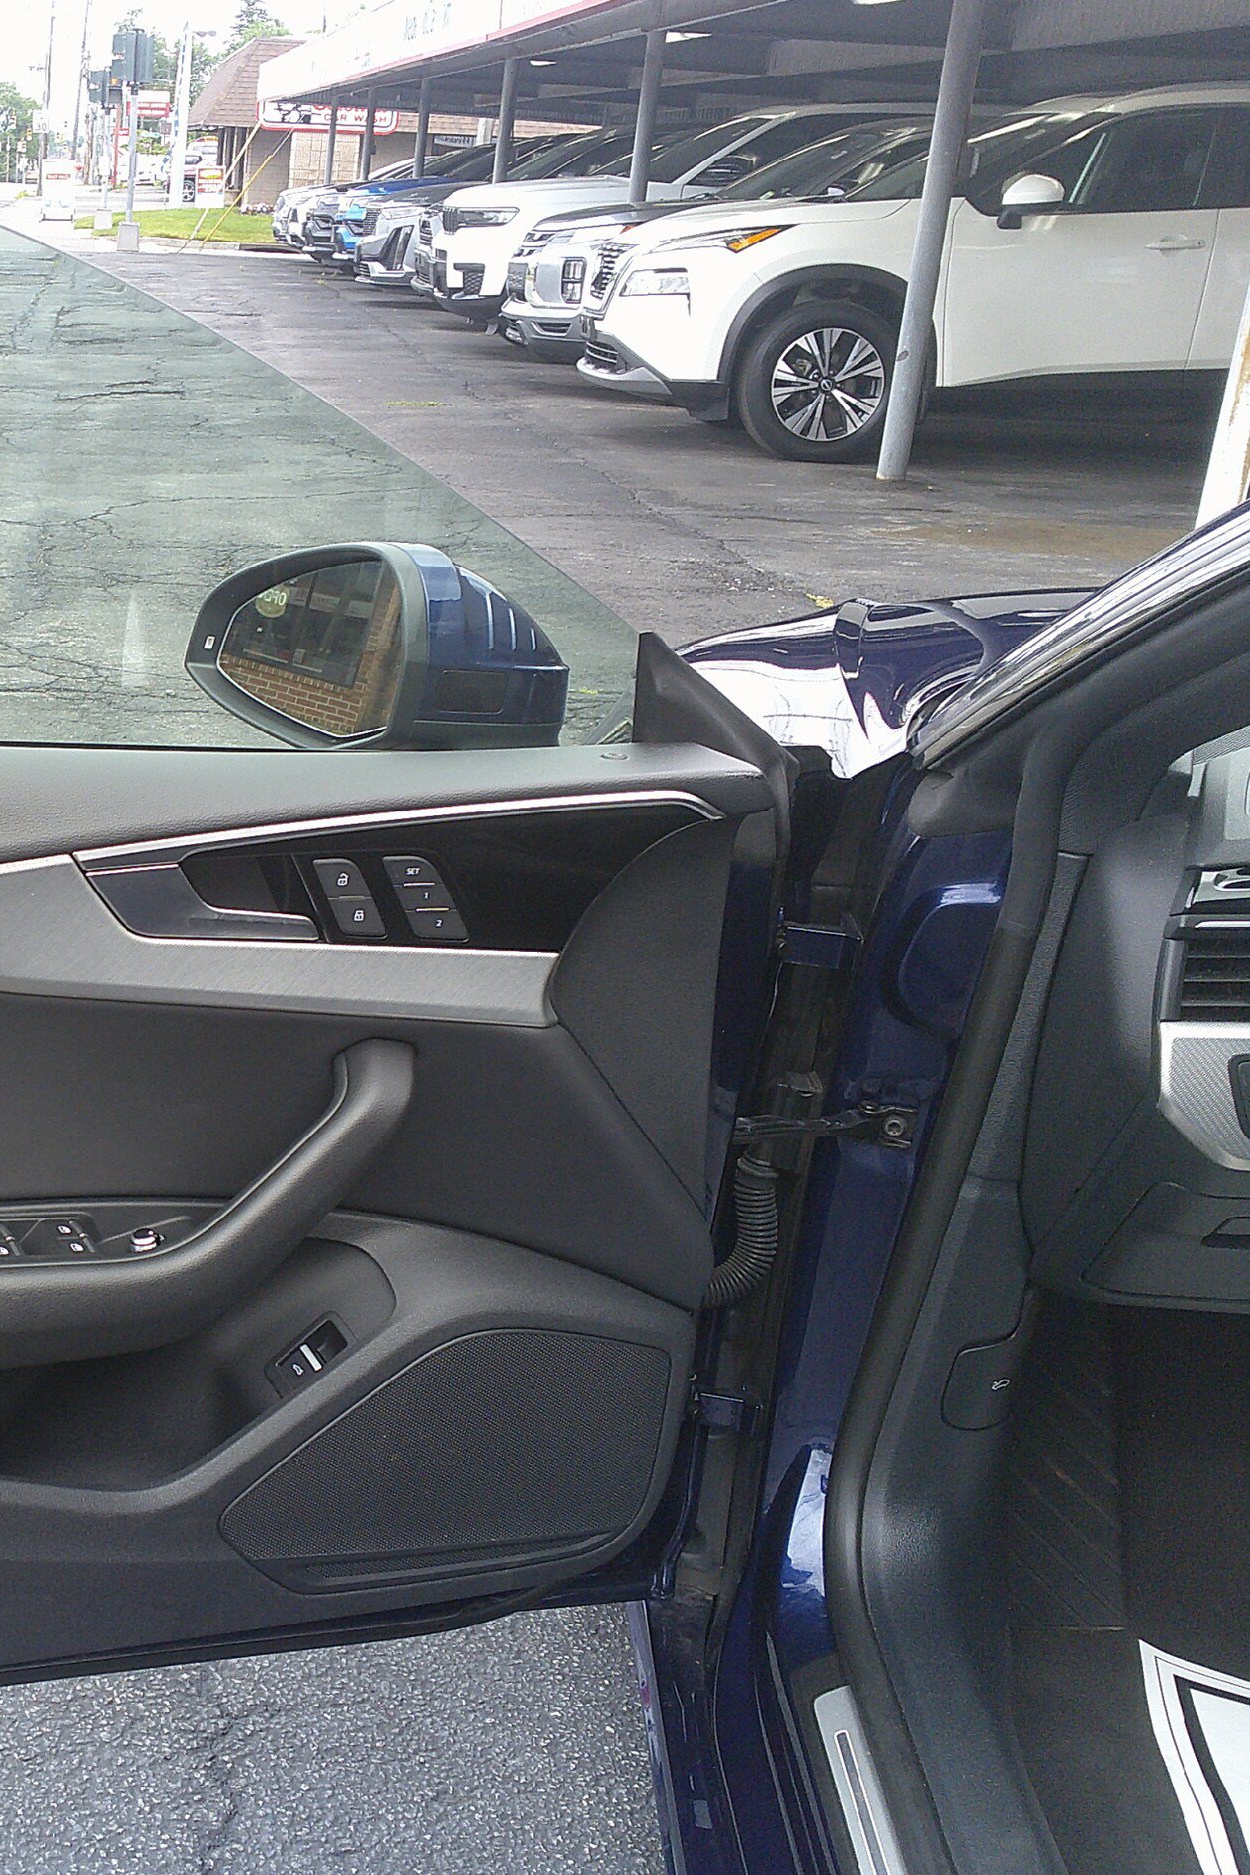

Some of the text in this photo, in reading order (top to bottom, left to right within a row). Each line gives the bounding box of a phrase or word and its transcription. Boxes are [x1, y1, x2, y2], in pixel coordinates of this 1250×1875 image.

[323, 113, 387, 123] CR WSH
[34, 122, 47, 132] 30
[405, 867, 421, 875] SET
[435, 919, 443, 927] 2
